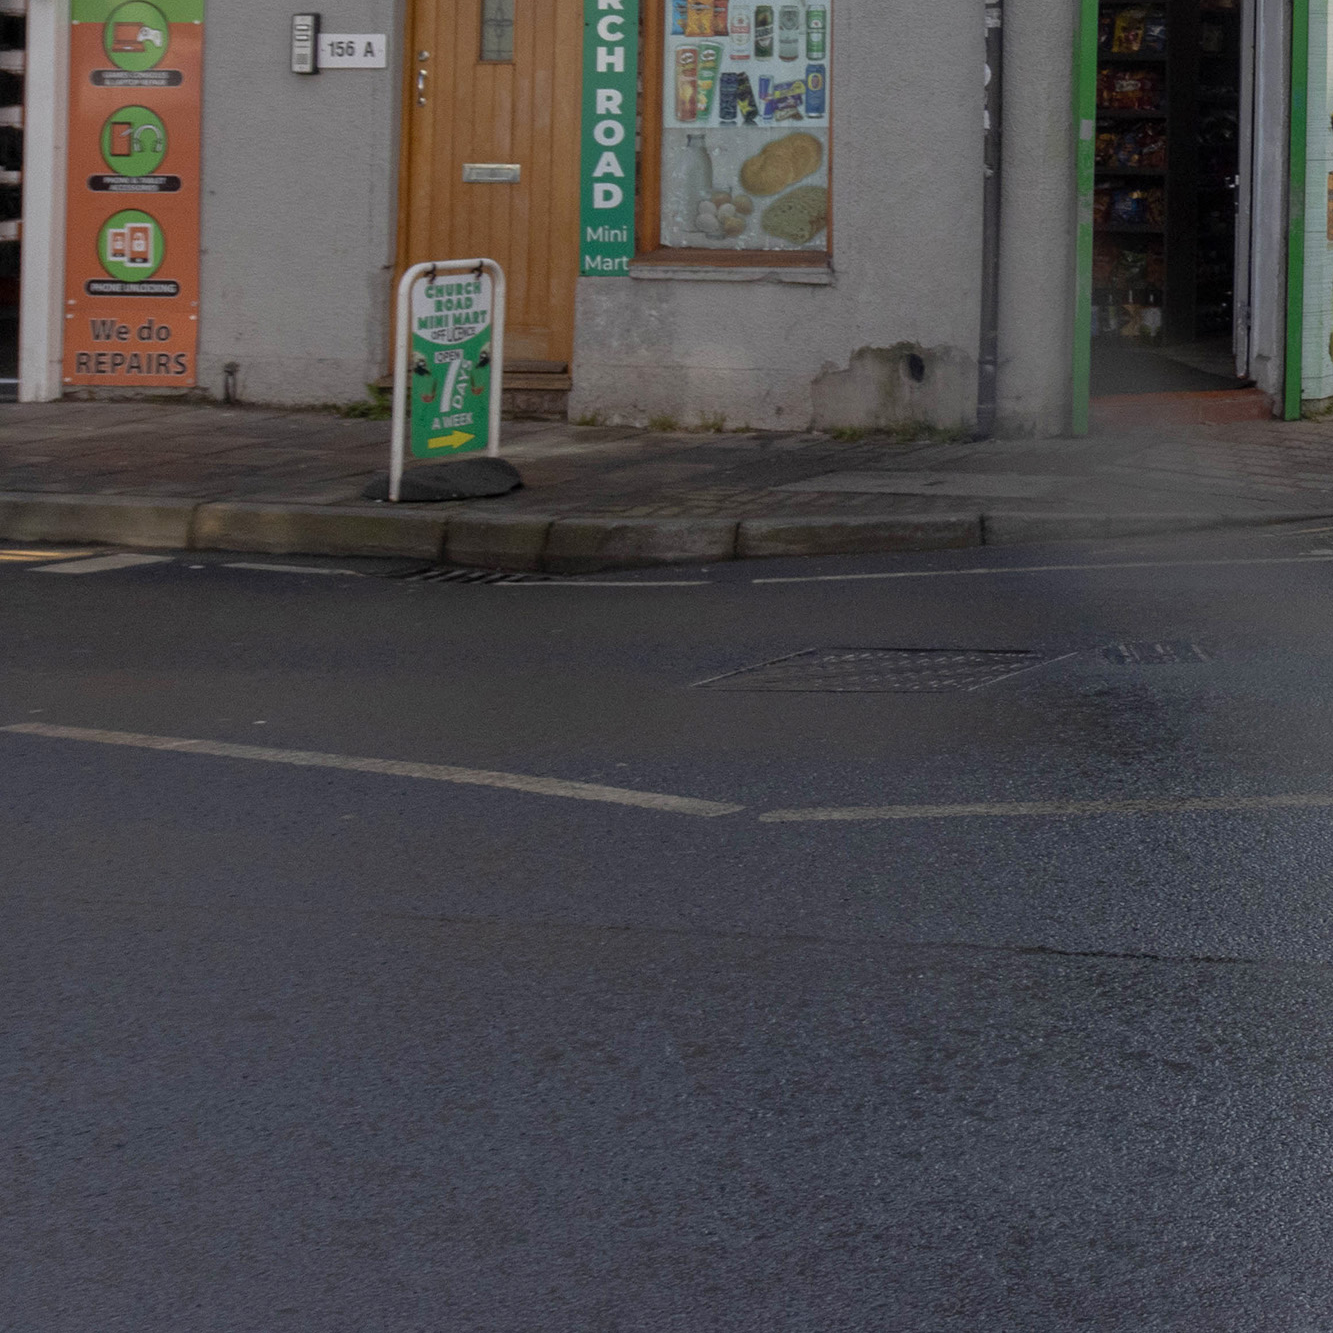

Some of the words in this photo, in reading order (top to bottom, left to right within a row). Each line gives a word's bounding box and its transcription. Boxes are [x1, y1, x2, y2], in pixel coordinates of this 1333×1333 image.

[328, 40, 356, 57] 156
[363, 40, 376, 57] A
[592, 88, 625, 210] ROAD
[586, 225, 628, 243] Mini
[584, 254, 630, 272] Mart
[424, 282, 482, 299] CHURCH
[434, 296, 473, 313] ROAD
[417, 315, 449, 331] MINI
[452, 309, 488, 326] MART
[90, 319, 130, 342] We
[137, 317, 171, 342] do
[431, 329, 446, 341] OFF
[447, 326, 477, 342] LICENCE
[75, 350, 187, 375] REPAIRS
[436, 351, 460, 363] OPEN
[434, 349, 464, 413] 7
[452, 360, 473, 410] DAYS
[432, 417, 441, 430] A
[443, 412, 474, 428] WEEK
